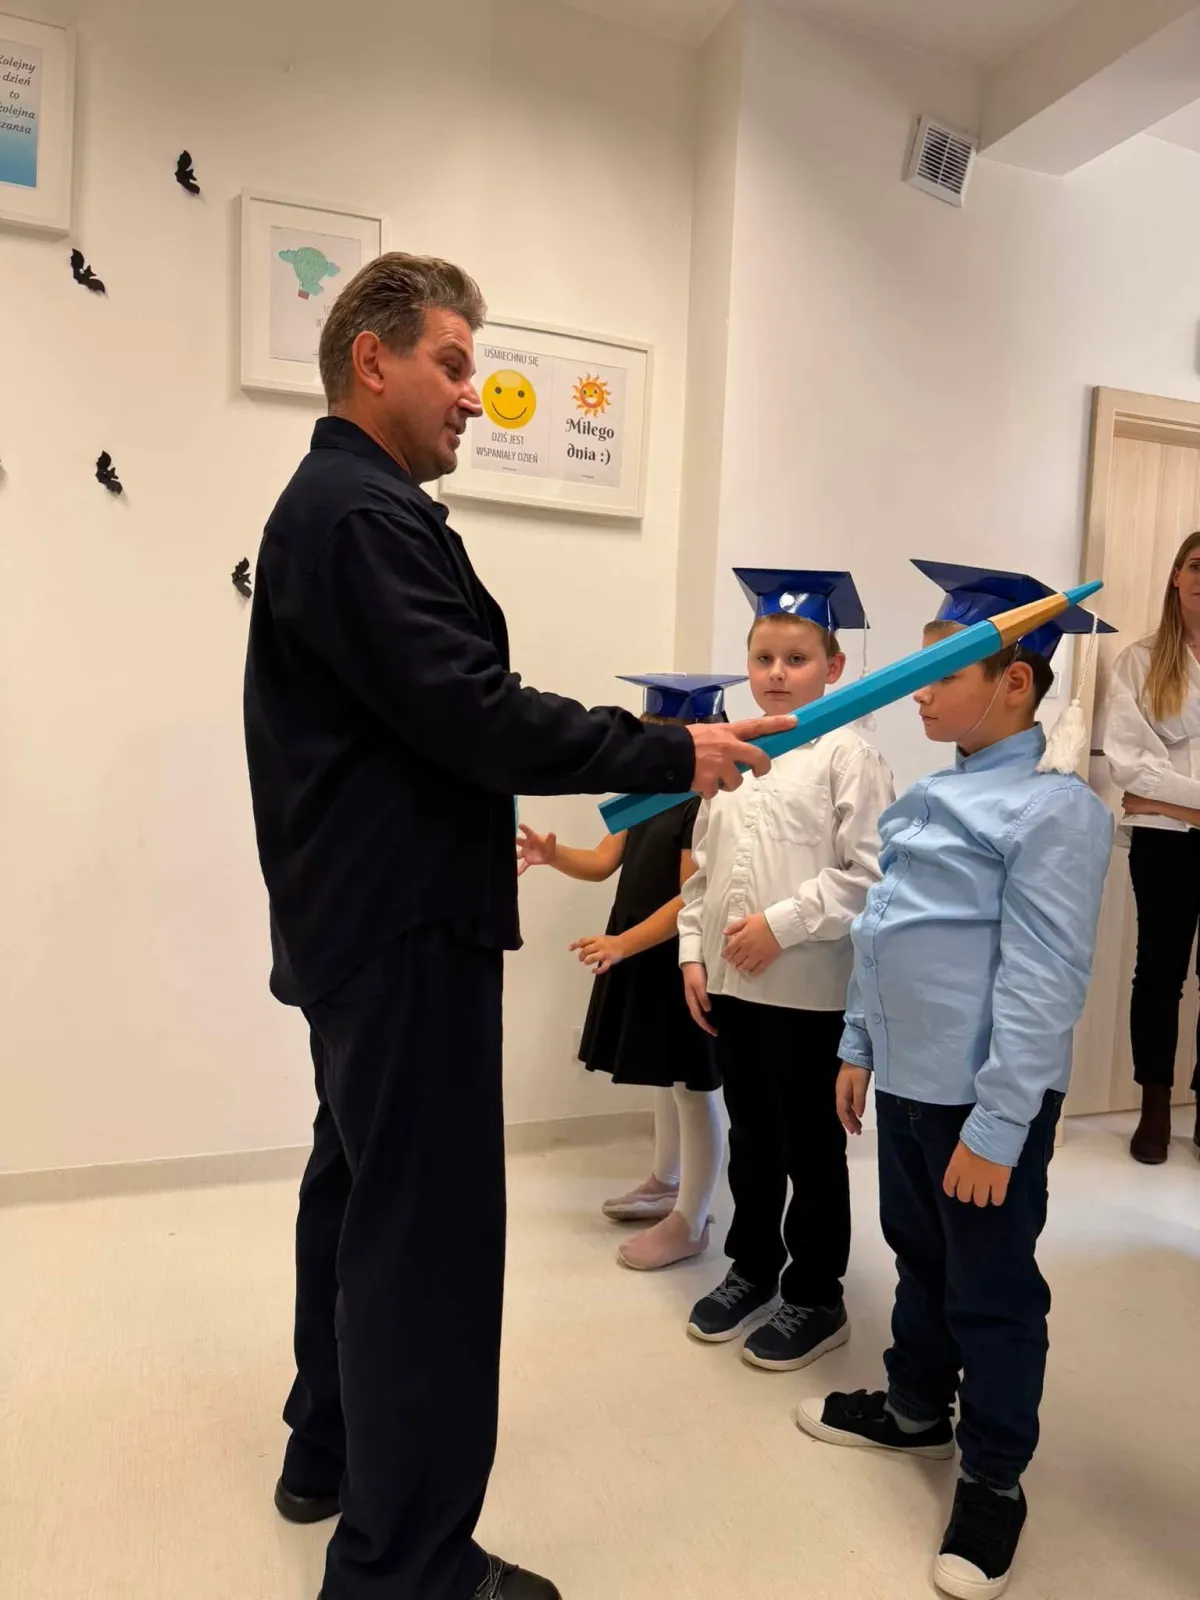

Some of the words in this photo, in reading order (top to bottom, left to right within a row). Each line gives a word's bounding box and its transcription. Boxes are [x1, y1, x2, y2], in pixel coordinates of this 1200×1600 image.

[2, 71, 31, 86] dzień
[9, 90, 20, 99] to
[0, 121, 32, 134] zansa
[528, 355, 539, 367] SIĘ
[565, 417, 615, 441] Miłego
[491, 431, 508, 443] DZIŚ
[509, 434, 524, 445] JEST
[476, 445, 516, 461] WSPANIAŁY
[517, 452, 539, 463] DZIEŃ
[567, 443, 596, 461] dnia
